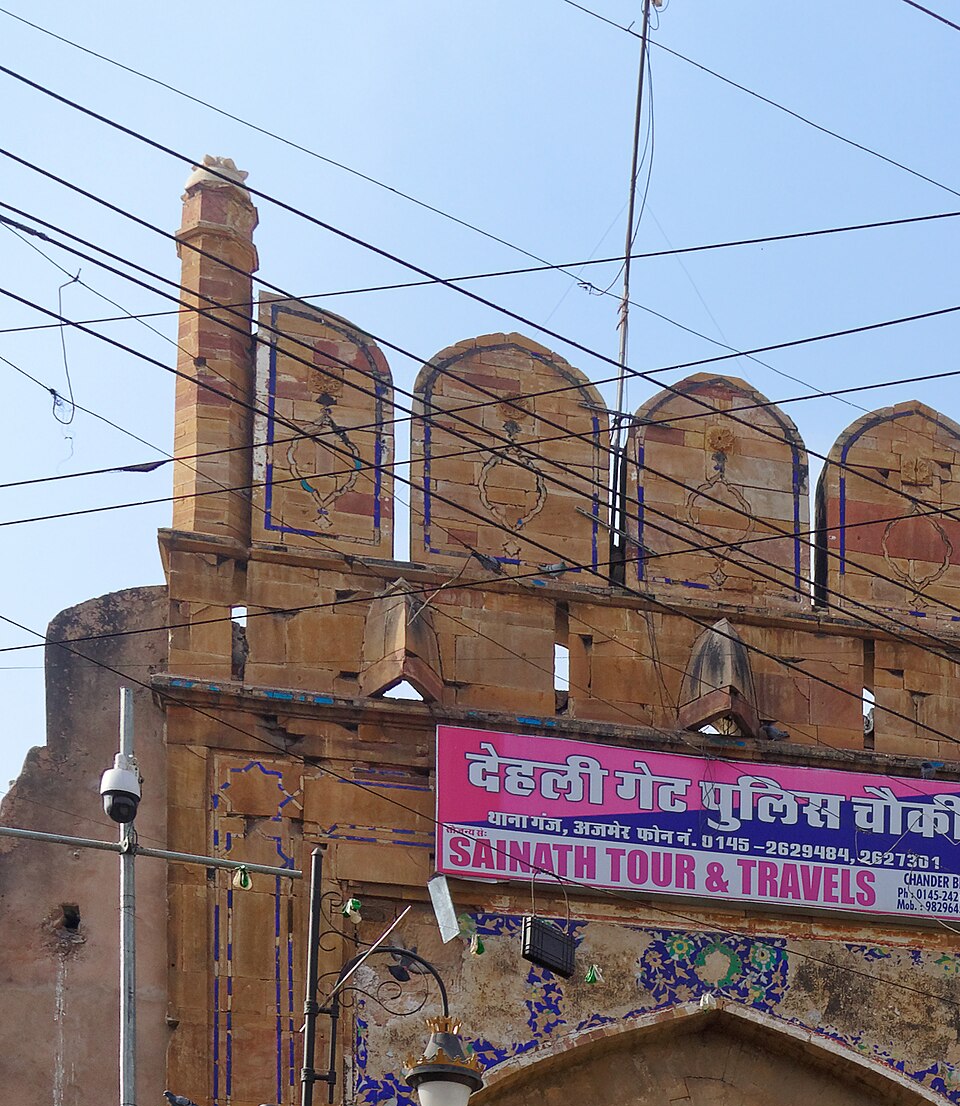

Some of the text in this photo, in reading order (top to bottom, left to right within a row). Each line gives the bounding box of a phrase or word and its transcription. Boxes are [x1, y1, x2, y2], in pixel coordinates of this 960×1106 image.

[465, 742, 608, 805] देहली
[614, 761, 691, 813] गेट
[699, 775, 846, 832] पुलिस
[573, 820, 630, 840] अजमेर
[636, 825, 674, 844] फोन
[450, 836, 876, 907] SAINATH TOUR & TRAVELS
[904, 873, 949, 889] CHANDER
